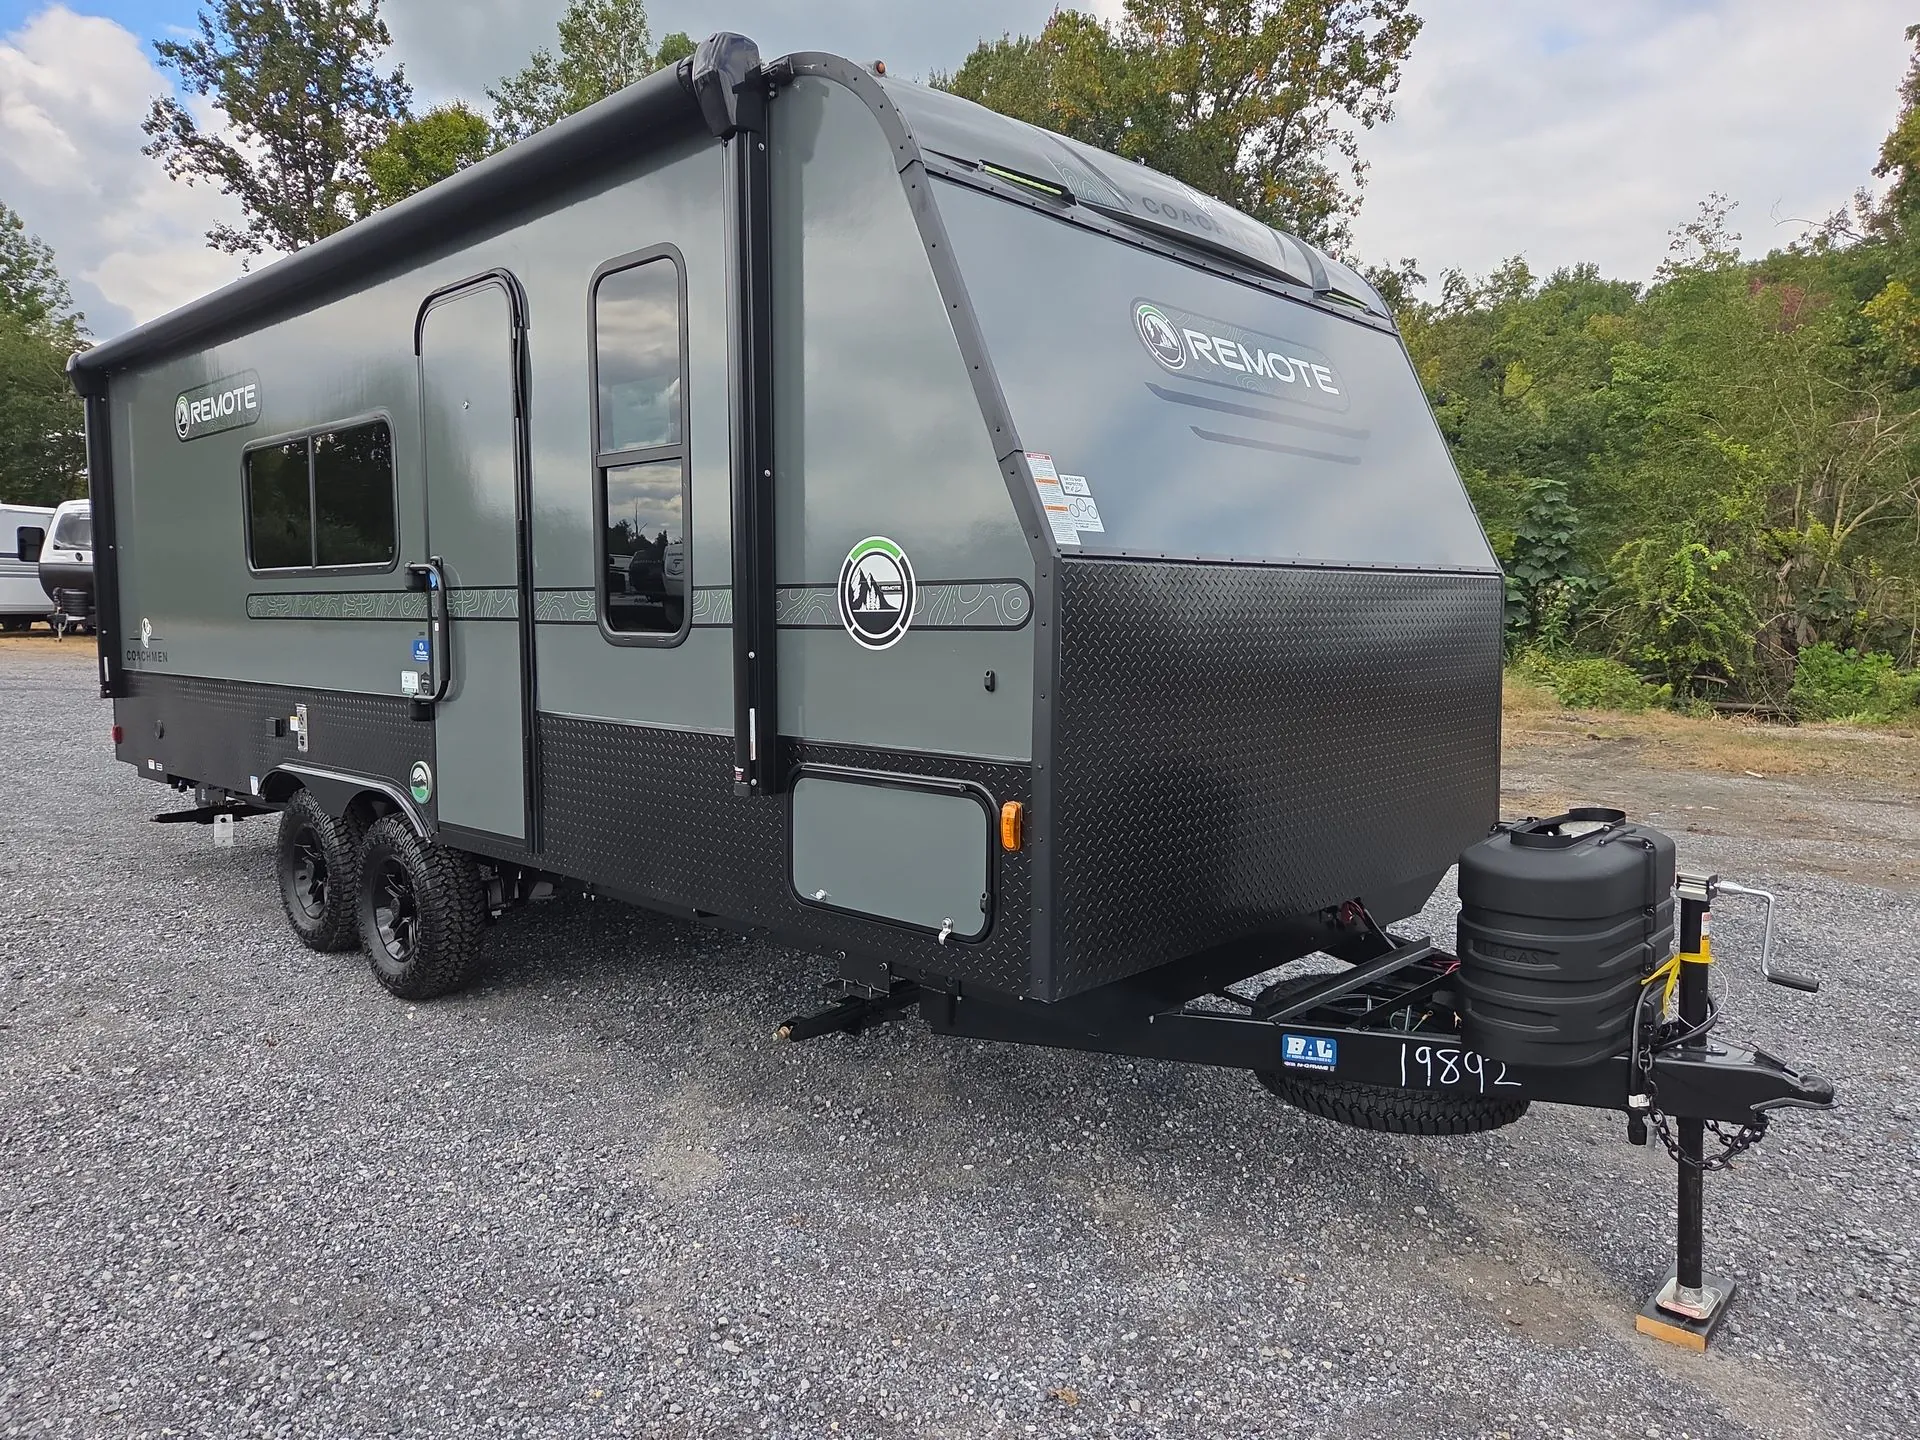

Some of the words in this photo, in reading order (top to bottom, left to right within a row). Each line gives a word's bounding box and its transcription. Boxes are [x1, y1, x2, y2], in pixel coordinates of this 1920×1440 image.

[1182, 328, 1340, 395] REMOTE
[190, 384, 256, 424] REMOTE
[126, 650, 168, 662] COACHMEN
[1401, 1043, 1522, 1094] 19892
